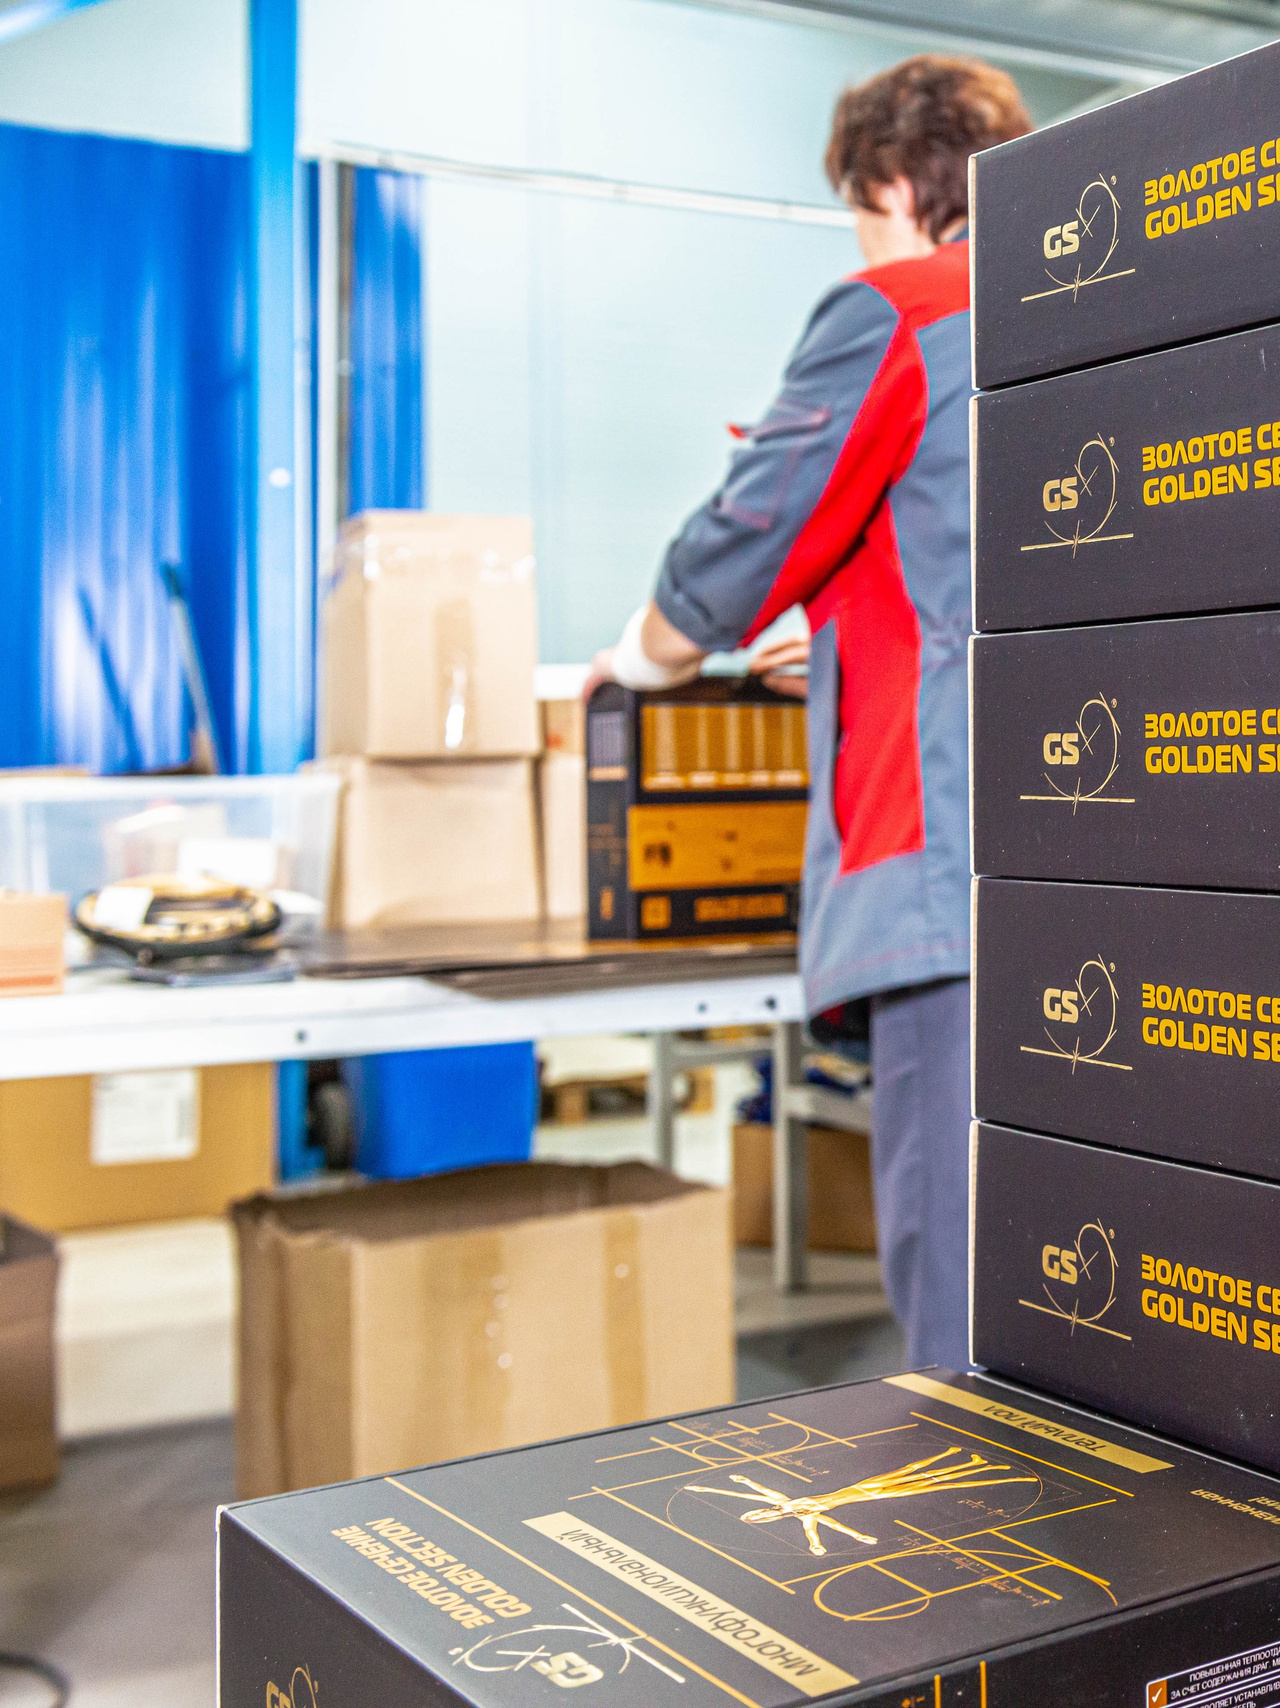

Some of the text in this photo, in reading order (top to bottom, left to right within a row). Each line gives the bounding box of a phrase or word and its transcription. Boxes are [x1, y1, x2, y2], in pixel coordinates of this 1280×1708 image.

[1144, 146, 1256, 206] ЗОЛОТОЕ
[1144, 181, 1252, 240] GOLDEN
[1043, 220, 1080, 259] GS
[1141, 426, 1253, 472] ЗОЛОТОЕ
[1042, 476, 1079, 512] GS
[1142, 461, 1249, 507] GOLDEN
[1144, 709, 1257, 739] ЗОЛОТОЕ
[1043, 732, 1080, 765] GS
[1144, 743, 1253, 774] GOLDEN
[1043, 987, 1079, 1024] GS
[1141, 982, 1252, 1021] ЗОЛОТОЕ
[1142, 1016, 1247, 1058] GOLDEN
[1042, 1244, 1078, 1285] GS
[1141, 1253, 1252, 1309] ЗОЛОТОЕ
[1141, 1288, 1248, 1345] GOLDEN
[330, 1525, 495, 1629] ЗОЛОТОЕ СЕЧЕНИЕ
[365, 1517, 533, 1618] GOLDEN SECTION
